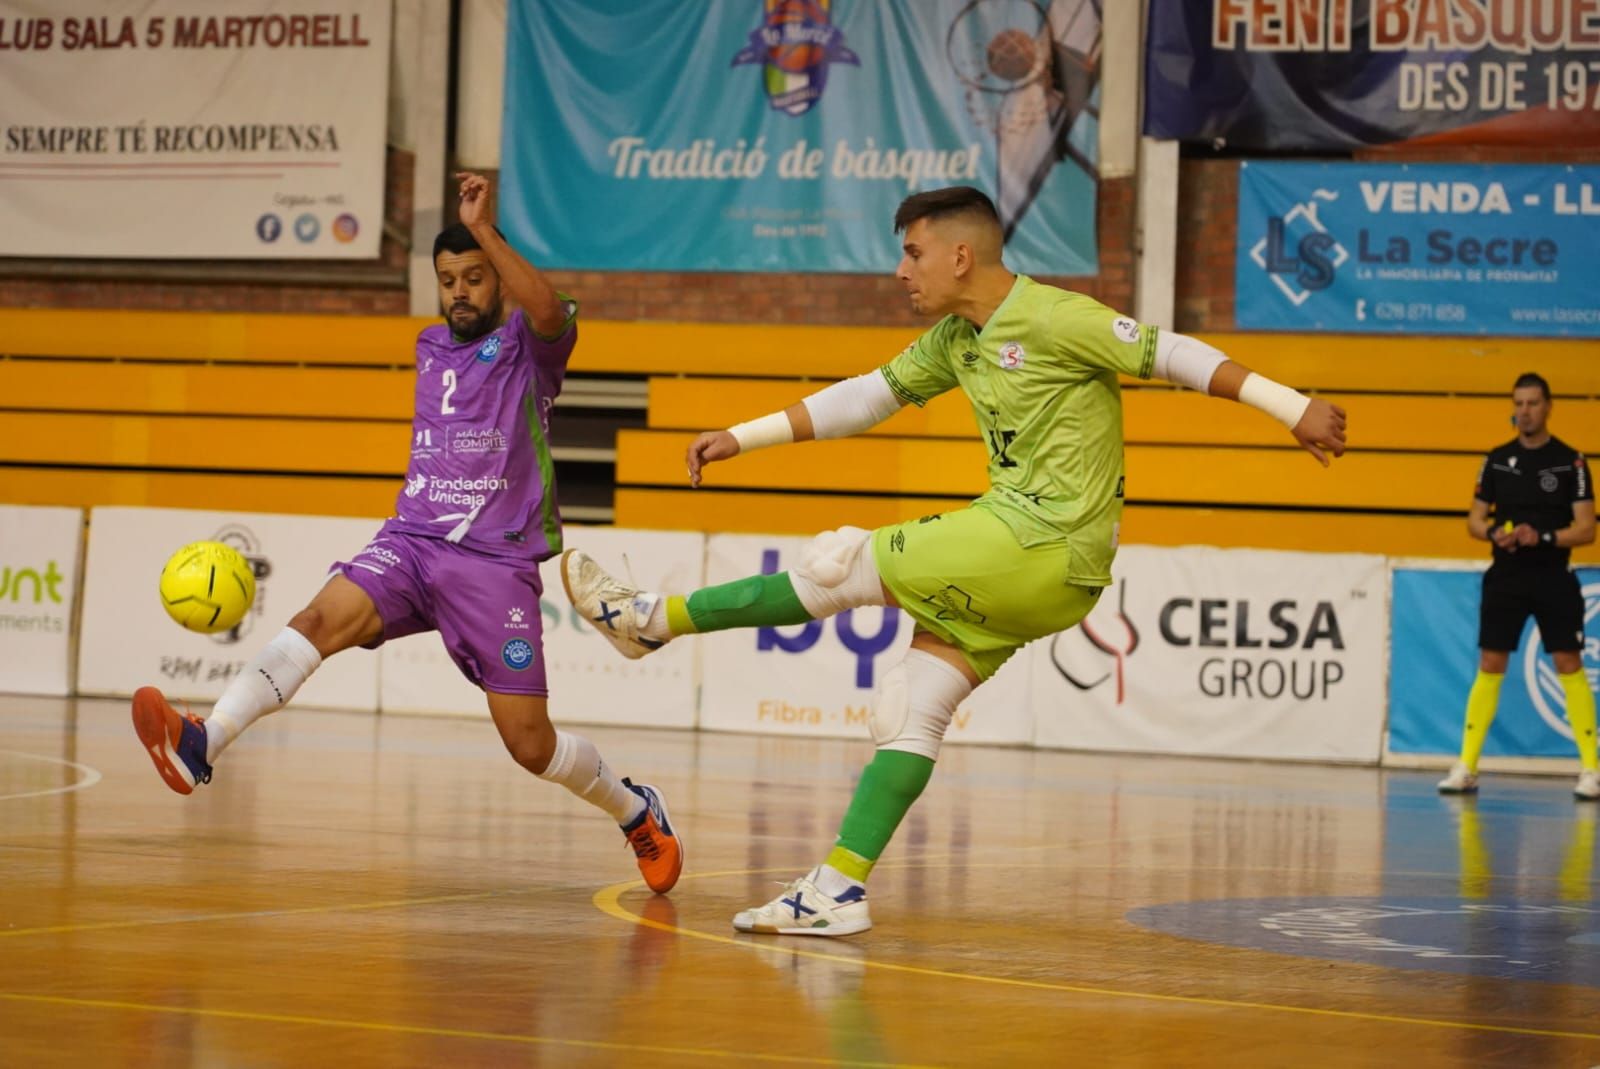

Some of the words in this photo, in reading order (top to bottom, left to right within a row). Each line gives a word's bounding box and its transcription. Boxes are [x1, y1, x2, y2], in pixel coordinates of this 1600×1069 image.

[62, 16, 137, 50] SALA
[146, 17, 165, 48] 5
[173, 14, 369, 48] MARTORELL
[1399, 62, 1469, 110] DES
[1480, 62, 1527, 110] DE
[6, 125, 108, 153] SEMPRE
[115, 119, 146, 153] TÉ
[154, 123, 340, 153] RECOMPENSA
[607, 136, 766, 179] Tradició
[778, 141, 824, 179] de
[832, 138, 981, 188] bàsquet
[1360, 181, 1512, 214] VENDA
[1358, 229, 1412, 264] La
[1427, 229, 1559, 266] Secre
[1467, 270, 1481, 281] DE
[441, 368, 457, 415] 2
[453, 437, 507, 449] COMPITE
[456, 427, 503, 438] MÁLAGA
[428, 489, 486, 509] Unicaja
[430, 475, 508, 491] Fundación
[1158, 597, 1345, 650] CELSA
[1199, 658, 1344, 700] GROUP
[758, 701, 822, 725] Fibra
